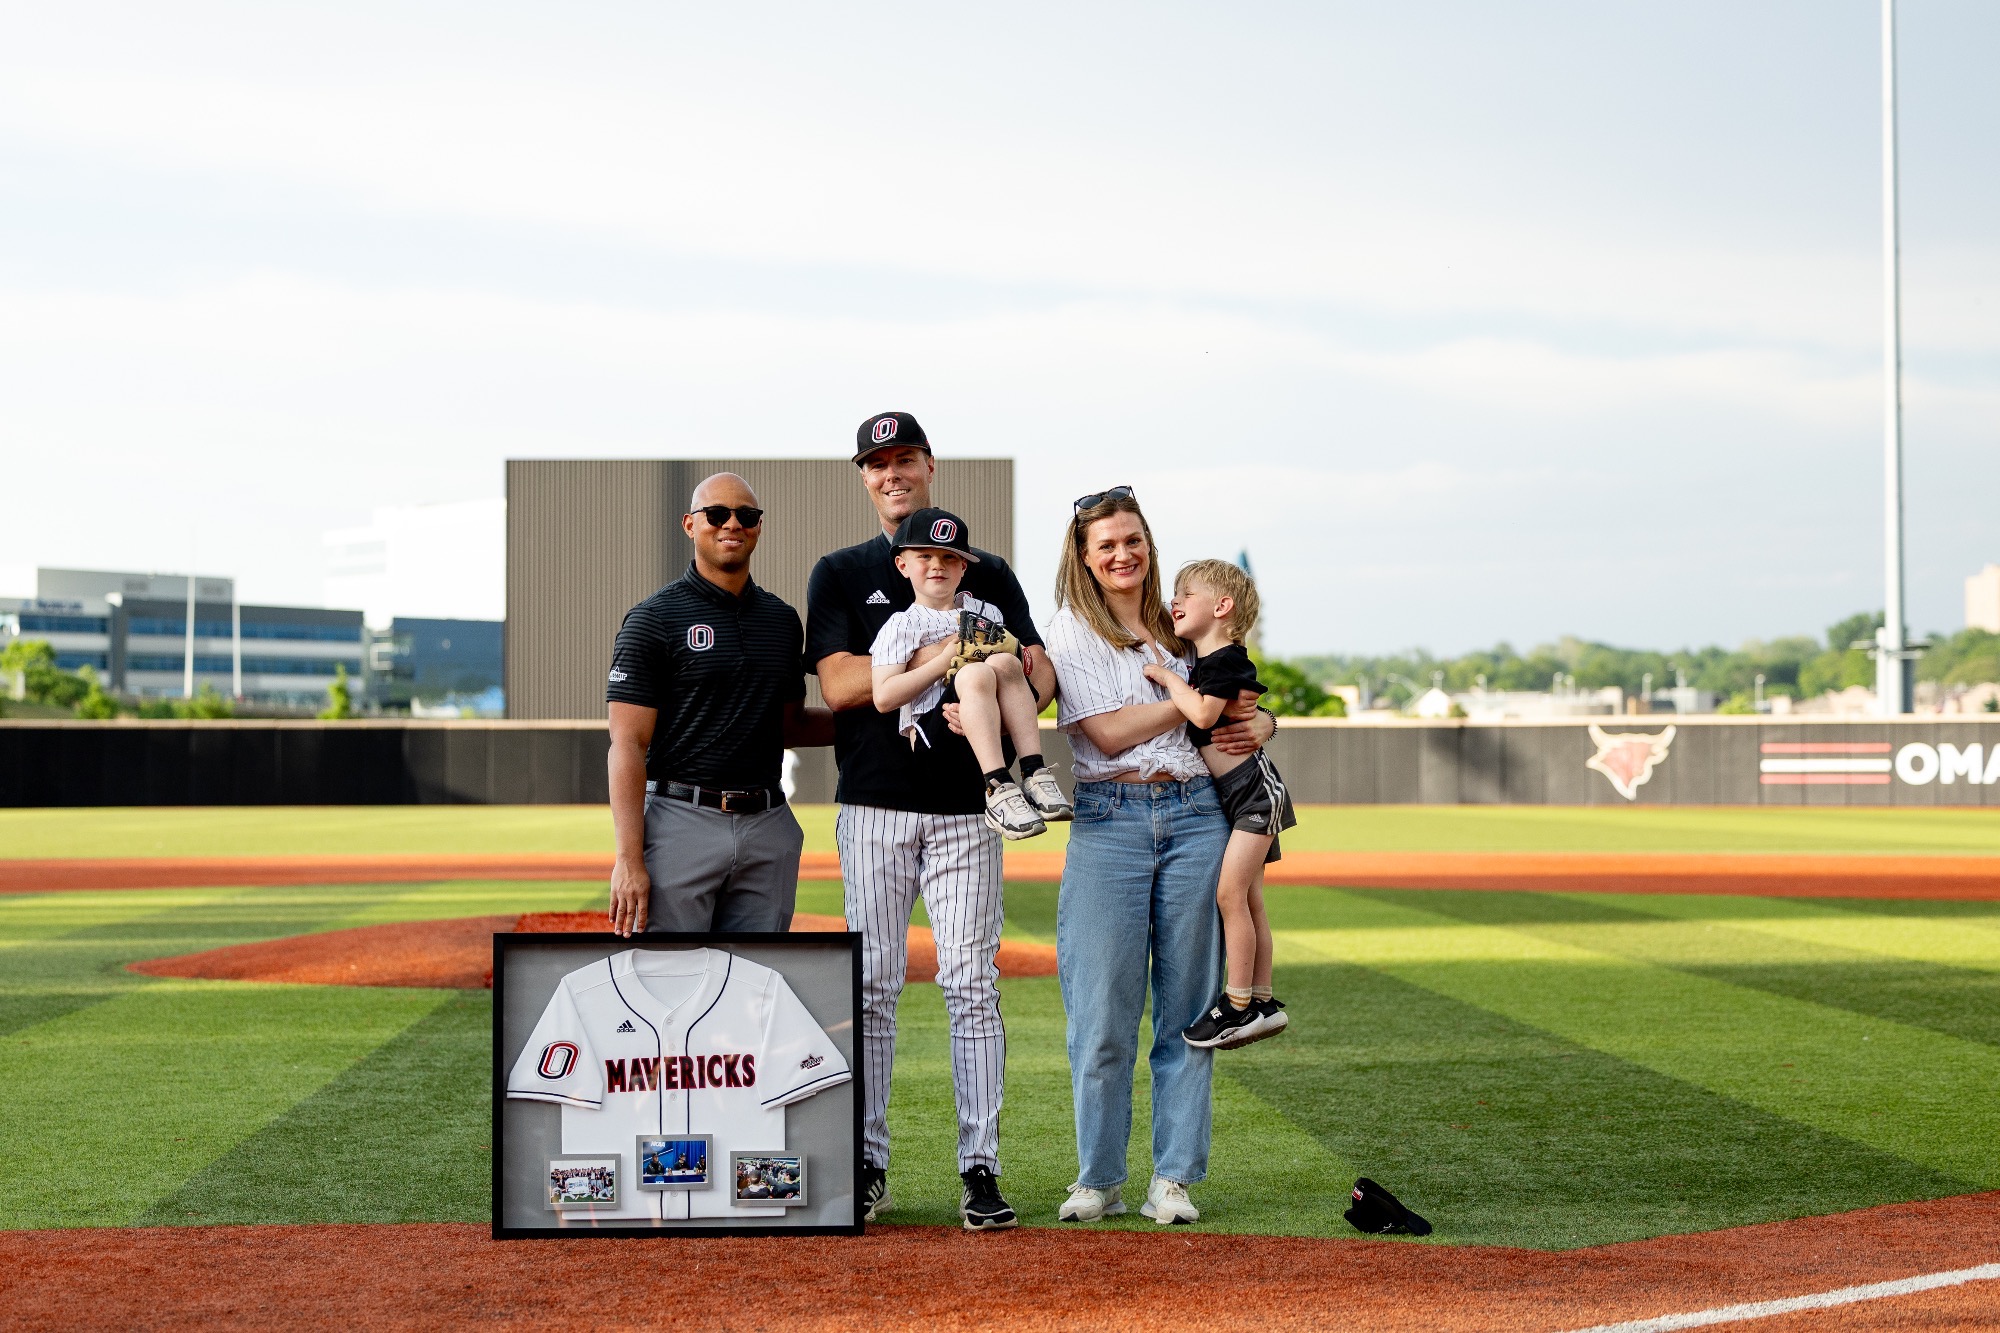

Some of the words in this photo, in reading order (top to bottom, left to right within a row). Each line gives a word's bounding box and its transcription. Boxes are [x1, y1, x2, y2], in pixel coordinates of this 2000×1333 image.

[872, 417, 898, 443] O
[930, 519, 957, 543] O
[687, 624, 714, 651] O
[535, 1041, 581, 1082] O
[605, 1053, 756, 1093] MAVERICKS
